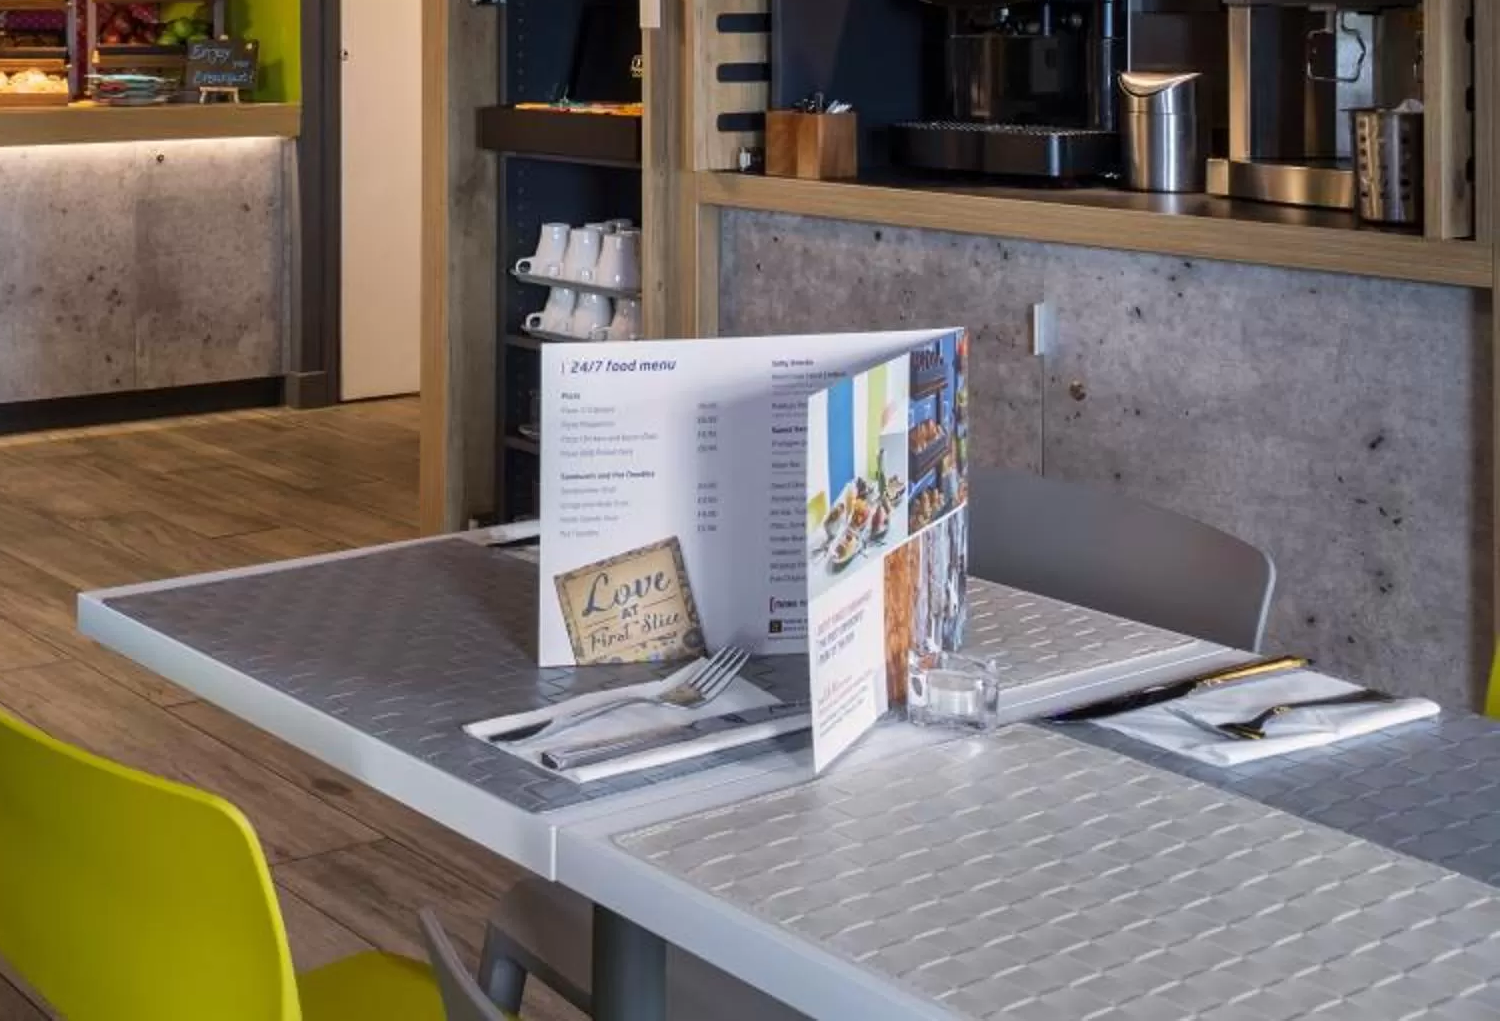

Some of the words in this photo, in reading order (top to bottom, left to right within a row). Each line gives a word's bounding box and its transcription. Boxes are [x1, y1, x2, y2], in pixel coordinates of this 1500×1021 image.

[570, 361, 603, 374] 24/7
[605, 359, 637, 372] food
[639, 360, 677, 371] menu
[582, 571, 672, 617] Love
[621, 603, 639, 619] AT
